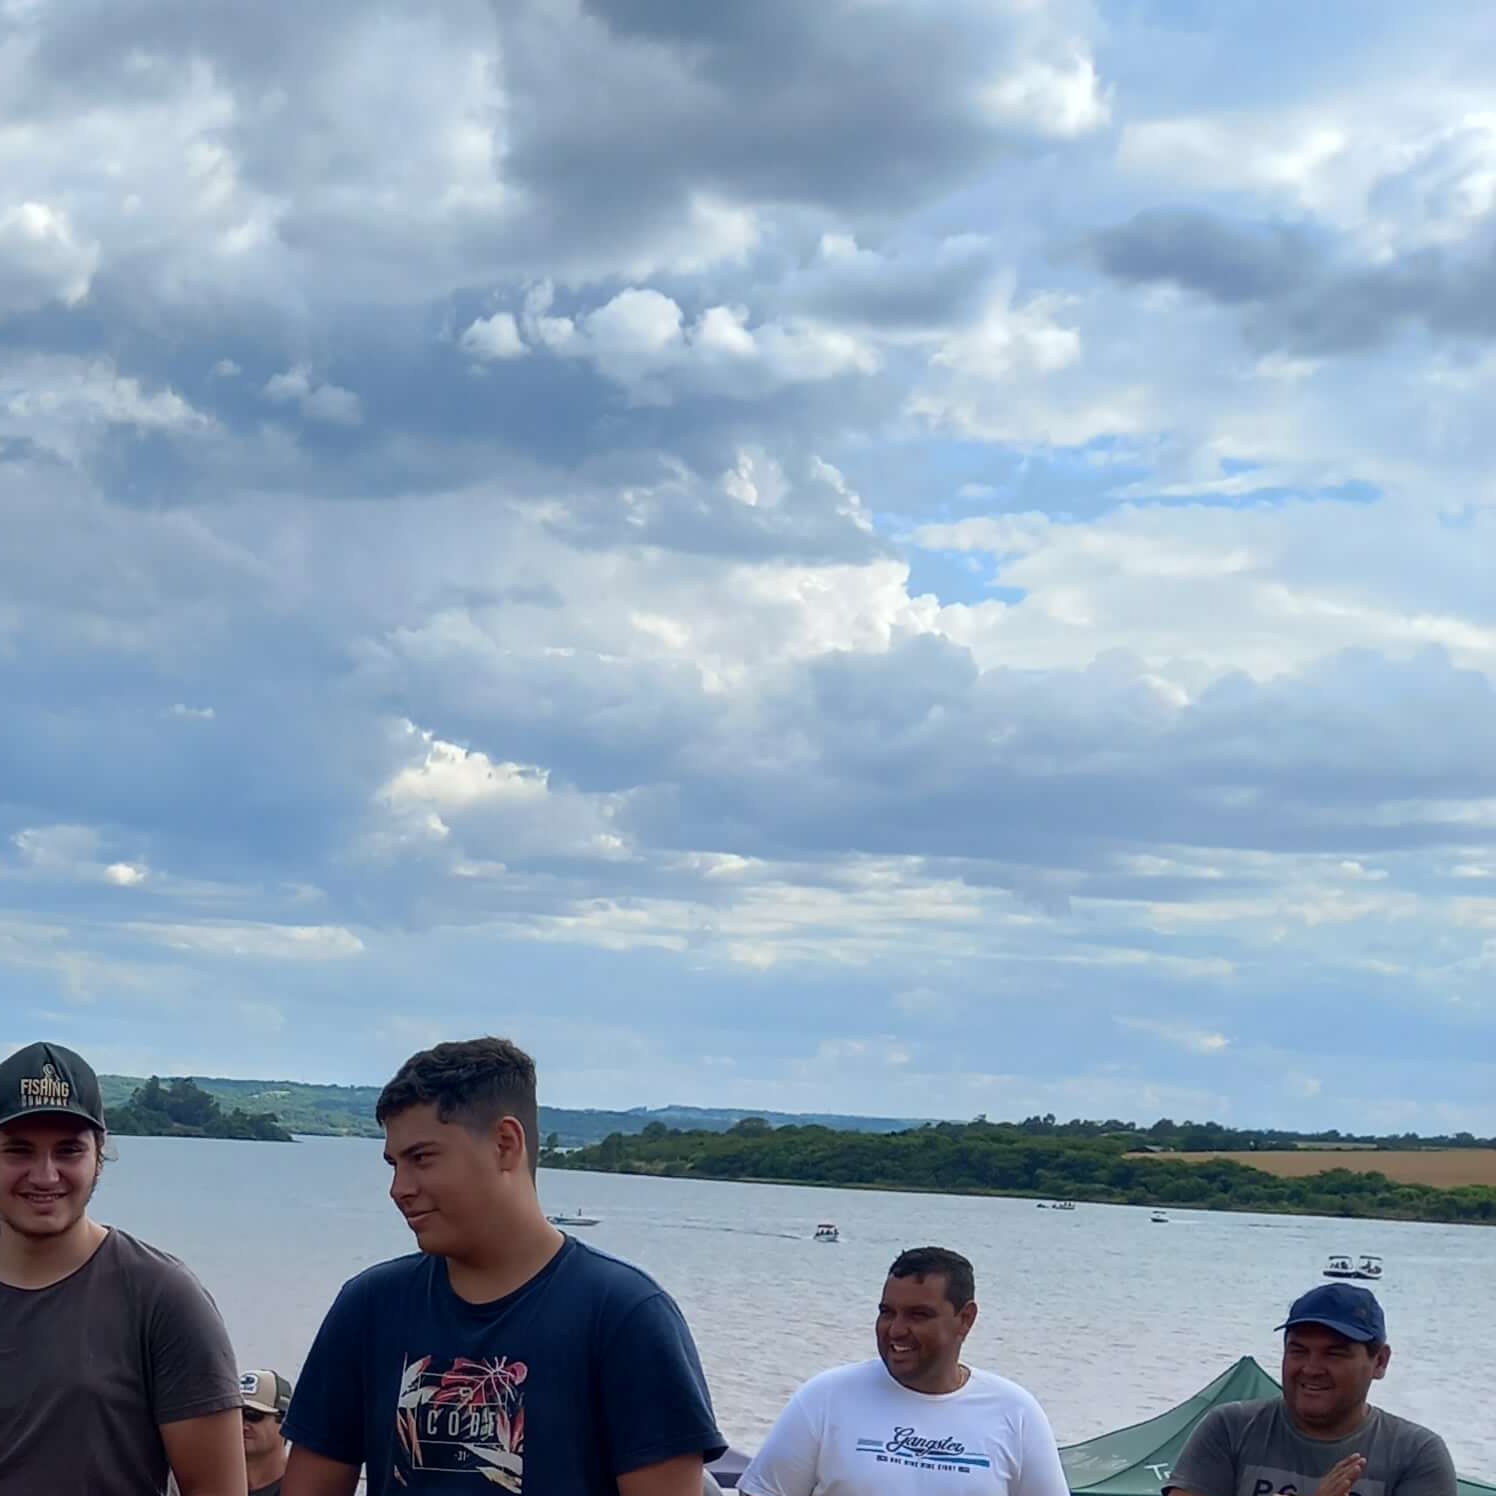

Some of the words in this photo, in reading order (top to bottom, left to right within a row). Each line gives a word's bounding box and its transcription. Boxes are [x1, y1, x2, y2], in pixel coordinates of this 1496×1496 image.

[20, 1078, 71, 1097] FISHING
[426, 1409, 498, 1438] CODE
[885, 1426, 965, 1457] Gangster
